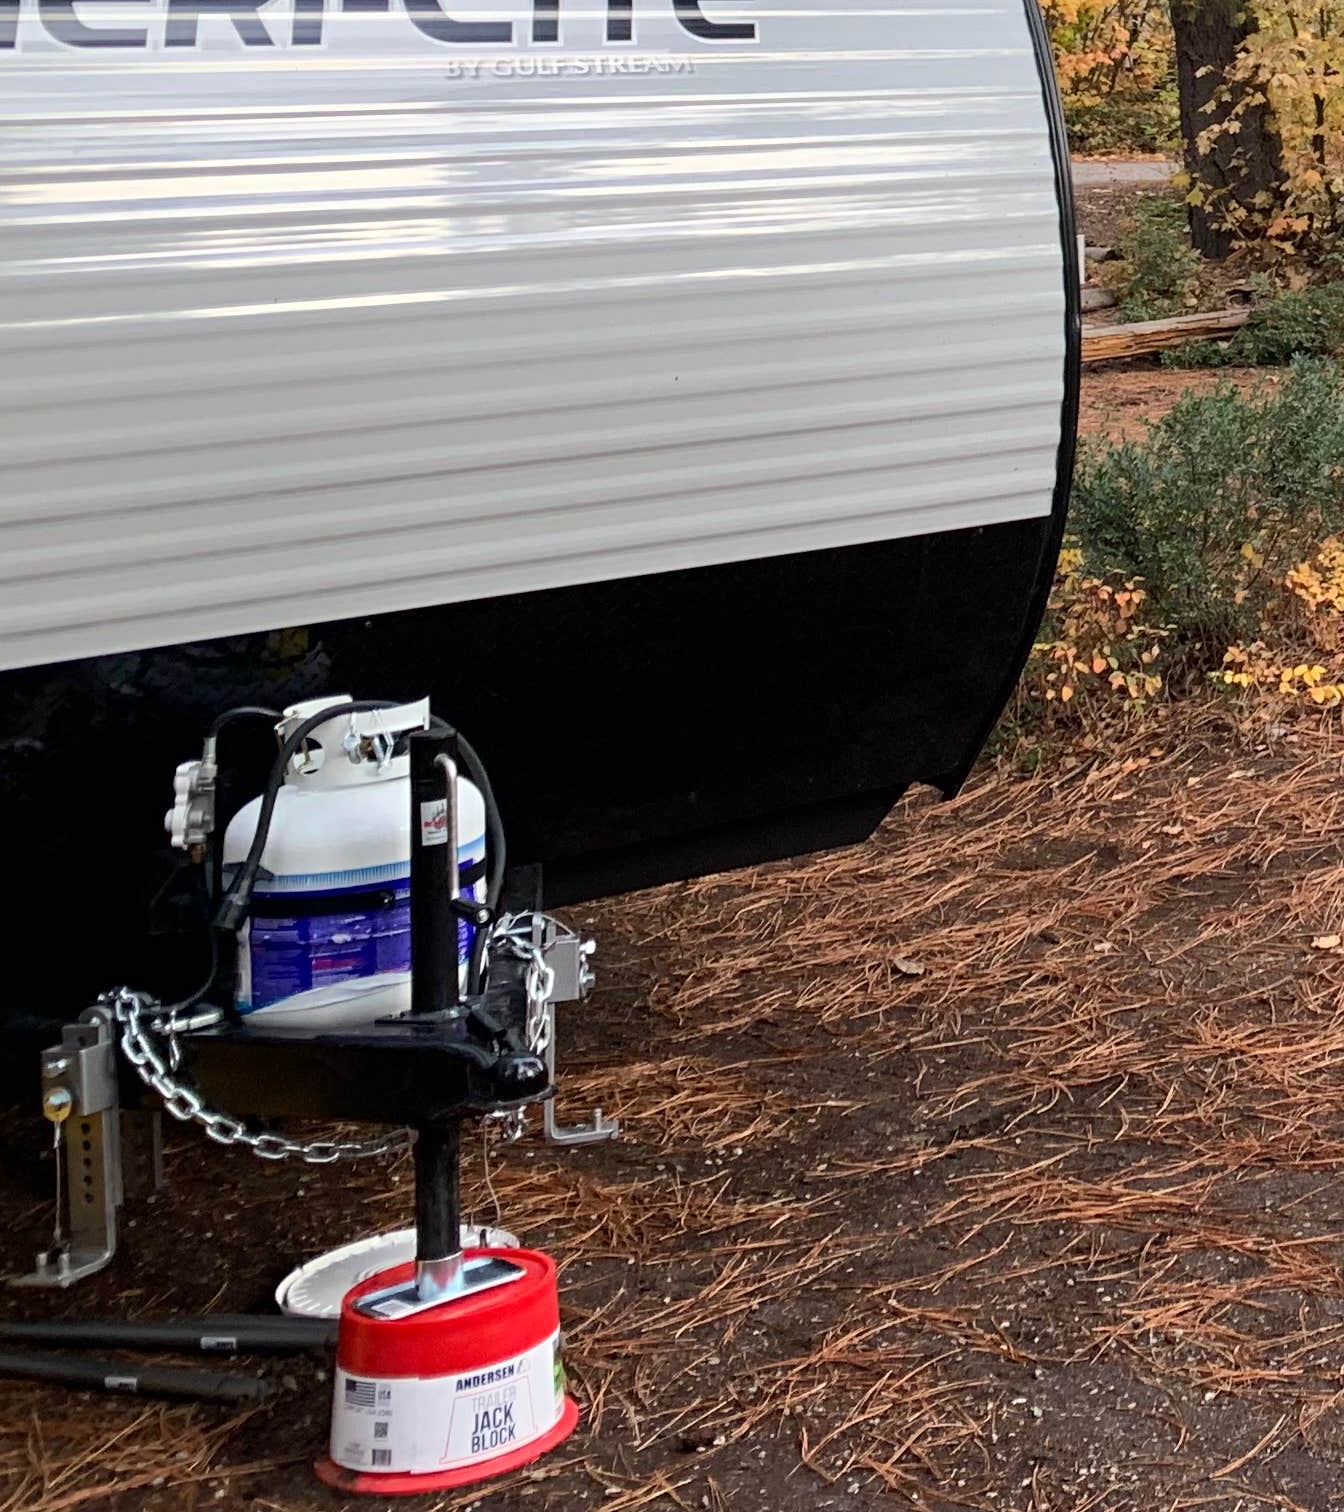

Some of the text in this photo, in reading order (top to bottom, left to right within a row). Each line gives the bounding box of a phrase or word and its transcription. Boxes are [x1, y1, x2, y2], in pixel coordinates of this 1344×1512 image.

[445, 54, 696, 80] BY GULF STREAM
[456, 1364, 515, 1392] ANDERSEN
[472, 1385, 517, 1412] TRAILER
[472, 1401, 514, 1436] JACK
[471, 1423, 516, 1454] BLOCK
